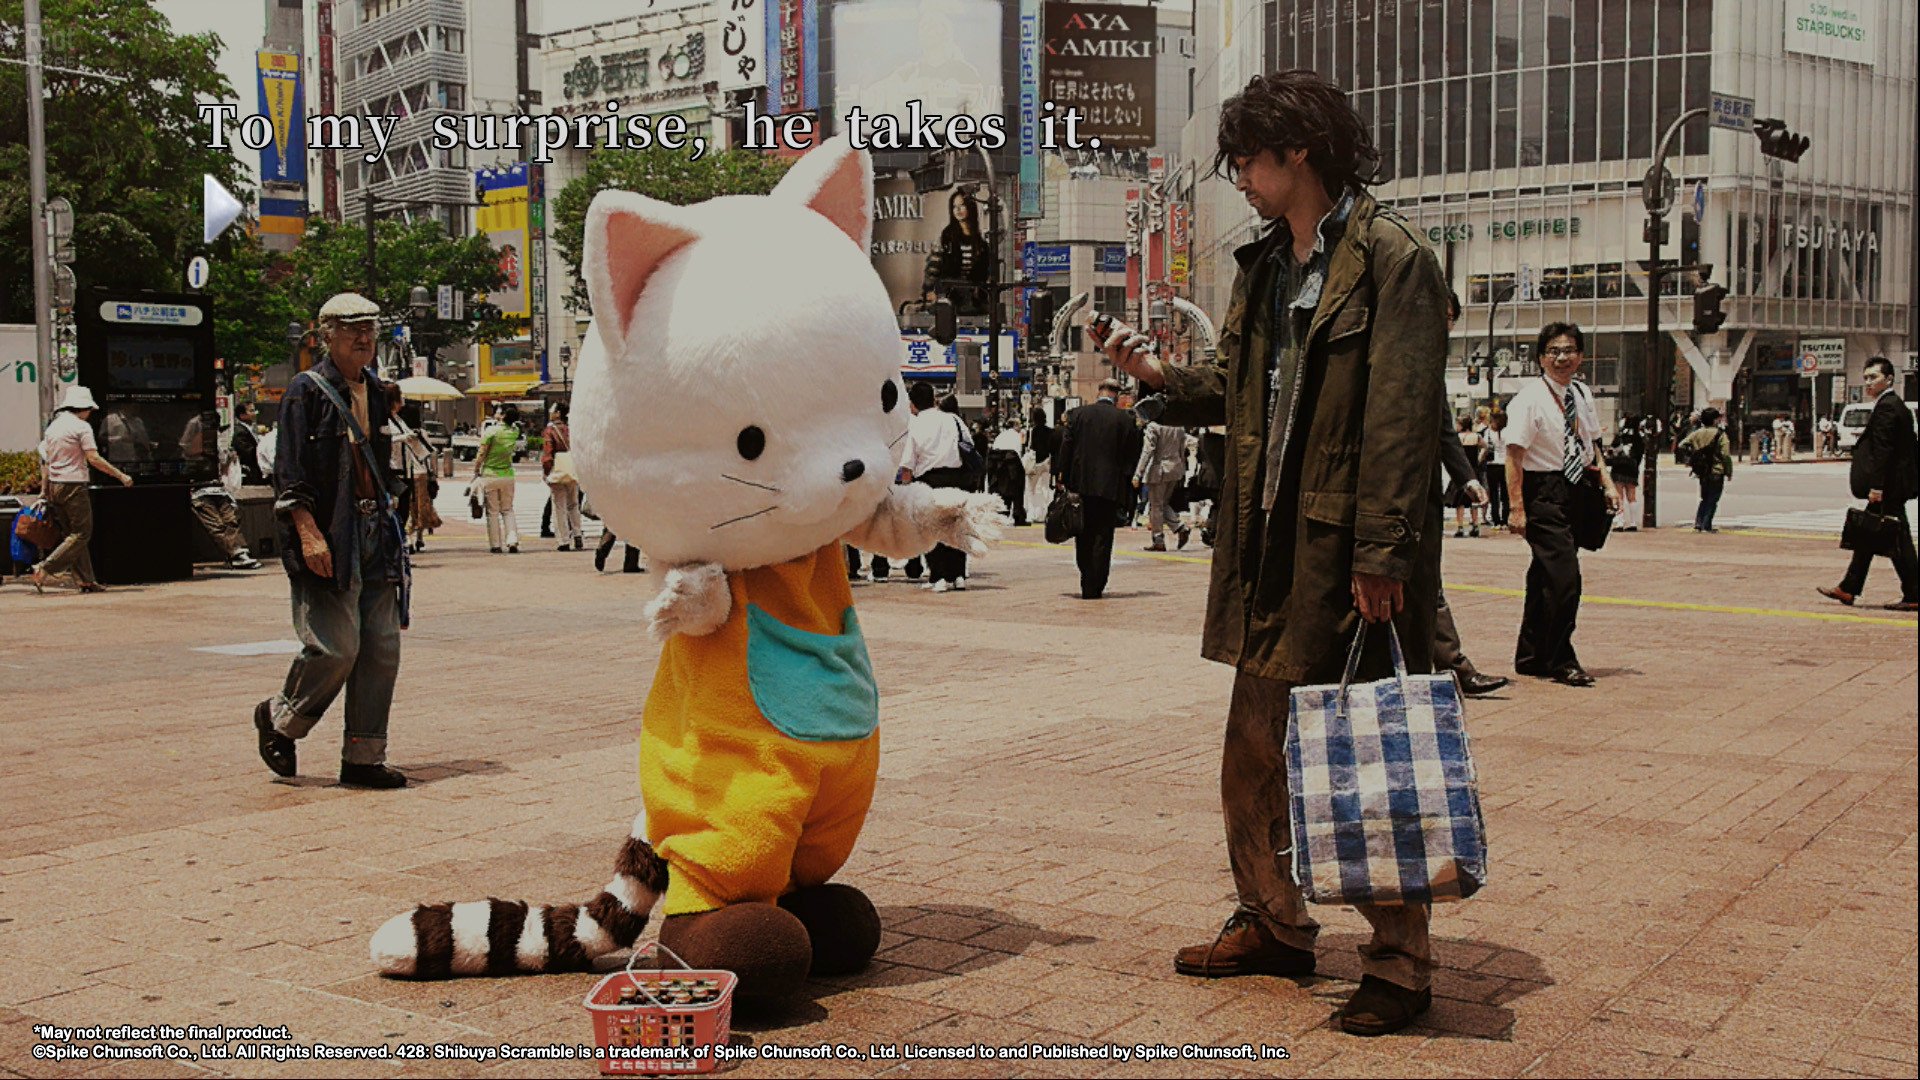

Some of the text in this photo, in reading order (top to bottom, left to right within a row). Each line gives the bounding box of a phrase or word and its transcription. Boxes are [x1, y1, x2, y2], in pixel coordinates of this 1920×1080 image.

[1063, 12, 1131, 32] AYA
[1795, 16, 1867, 42] STARBUCKS!
[1045, 37, 1152, 59] KAMIKI
[873, 193, 926, 220] AMIKI
[1487, 216, 1582, 241] COFFEE
[1782, 223, 1879, 254] TSUTAYA
[1802, 343, 1843, 352] TSUTAYA
